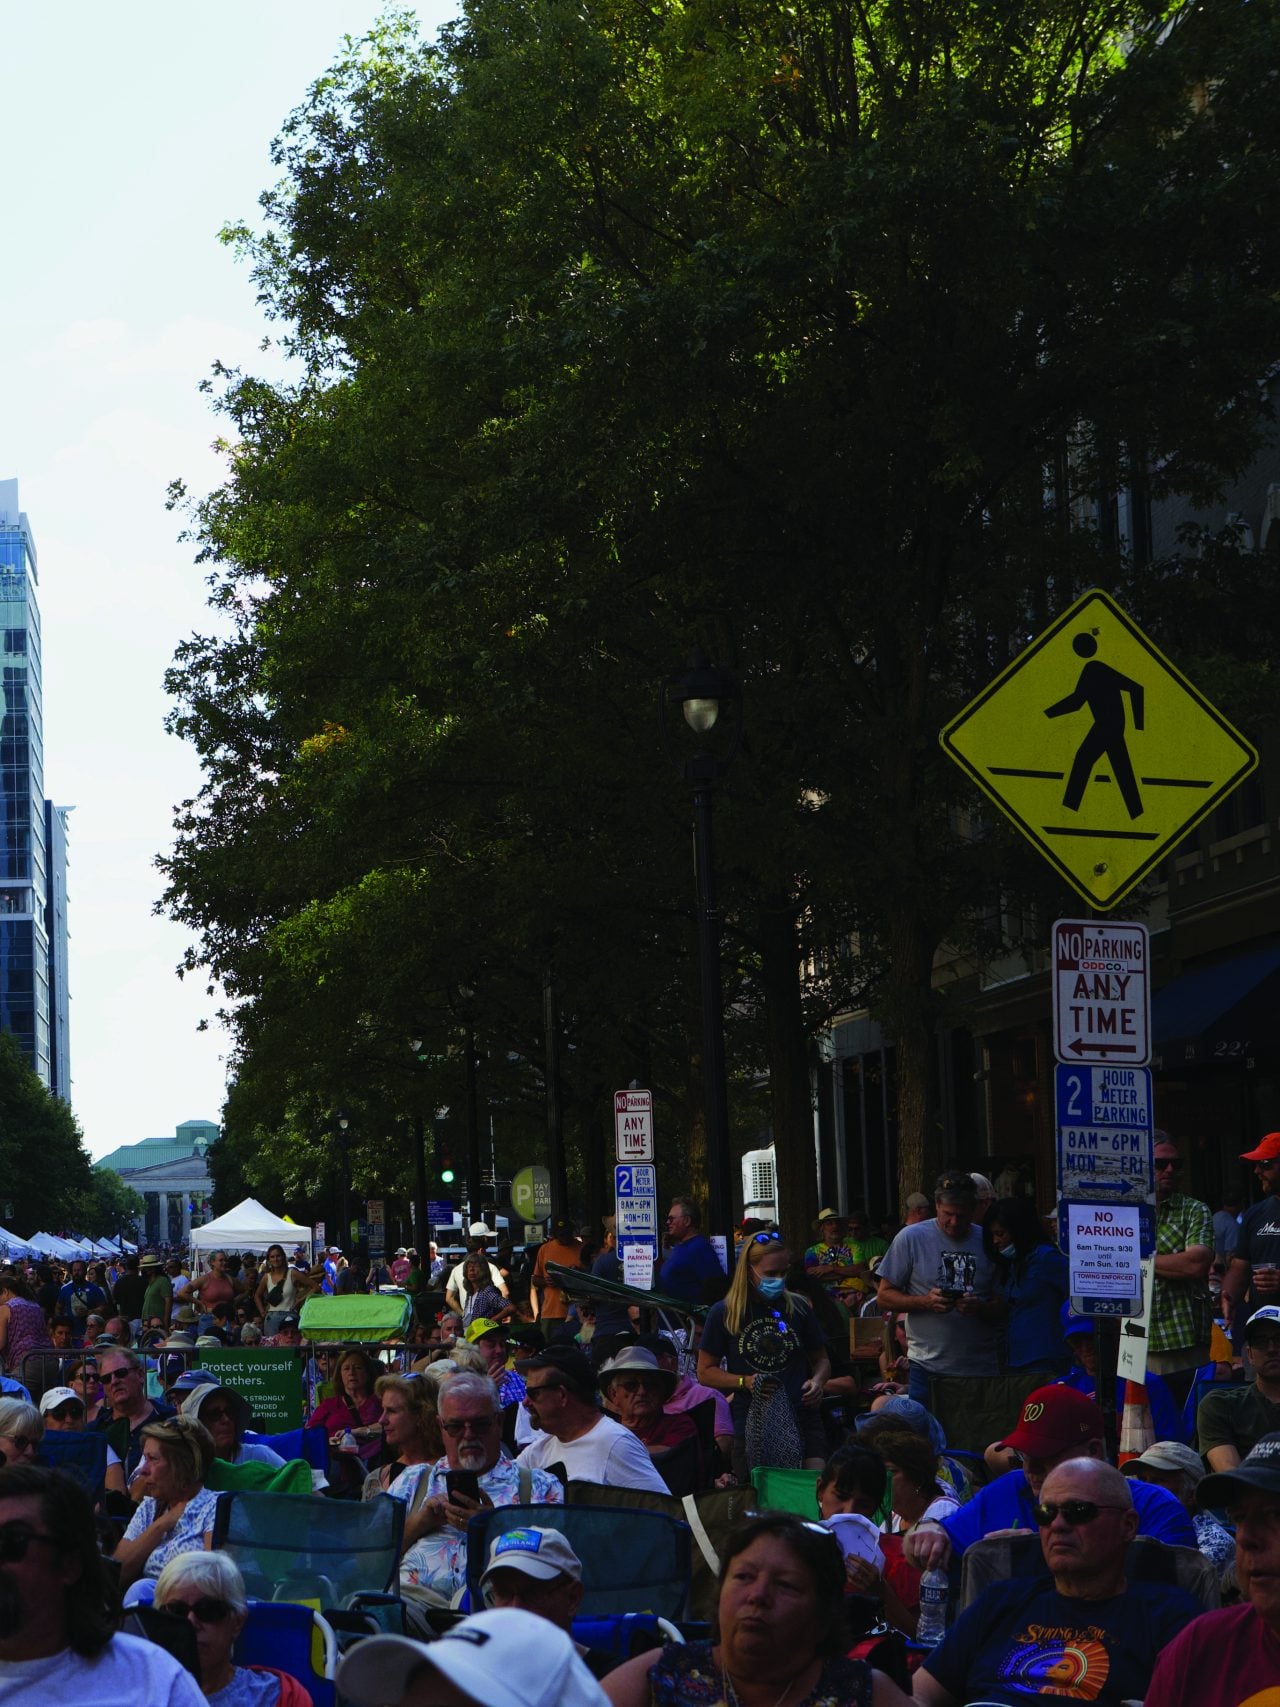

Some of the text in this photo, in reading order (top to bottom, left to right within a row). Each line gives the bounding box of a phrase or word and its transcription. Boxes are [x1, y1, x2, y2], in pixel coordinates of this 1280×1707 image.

[1058, 933, 1141, 960] NO PARKING
[1082, 962, 1125, 972] ODDCO.
[1073, 974, 1131, 1001] ANY
[1070, 1006, 1136, 1035] TIME
[1103, 1070, 1135, 1086] HOUR
[1067, 1075, 1082, 1116] 2
[1102, 1088, 1137, 1104] METER
[617, 1096, 650, 1109] NO PARKING
[1094, 1106, 1146, 1123] PARKING
[624, 1117, 644, 1130] ANY
[623, 1134, 646, 1147] TIME
[1066, 1153, 1096, 1171] MON
[1121, 1156, 1143, 1174] FRI
[636, 1168, 649, 1176] HOUR
[618, 1170, 630, 1192] 2
[636, 1177, 650, 1186] METER
[517, 1184, 532, 1205] P
[633, 1186, 655, 1194] PARKING
[1094, 1212, 1114, 1223] NO
[1077, 1225, 1134, 1237] PARKING
[1094, 1244, 1117, 1252] Thurs.
[1080, 1260, 1095, 1268] 7am
[1097, 1260, 1113, 1268] Sun.
[201, 1361, 293, 1373] Protect yourself
[225, 1375, 266, 1385] others.
